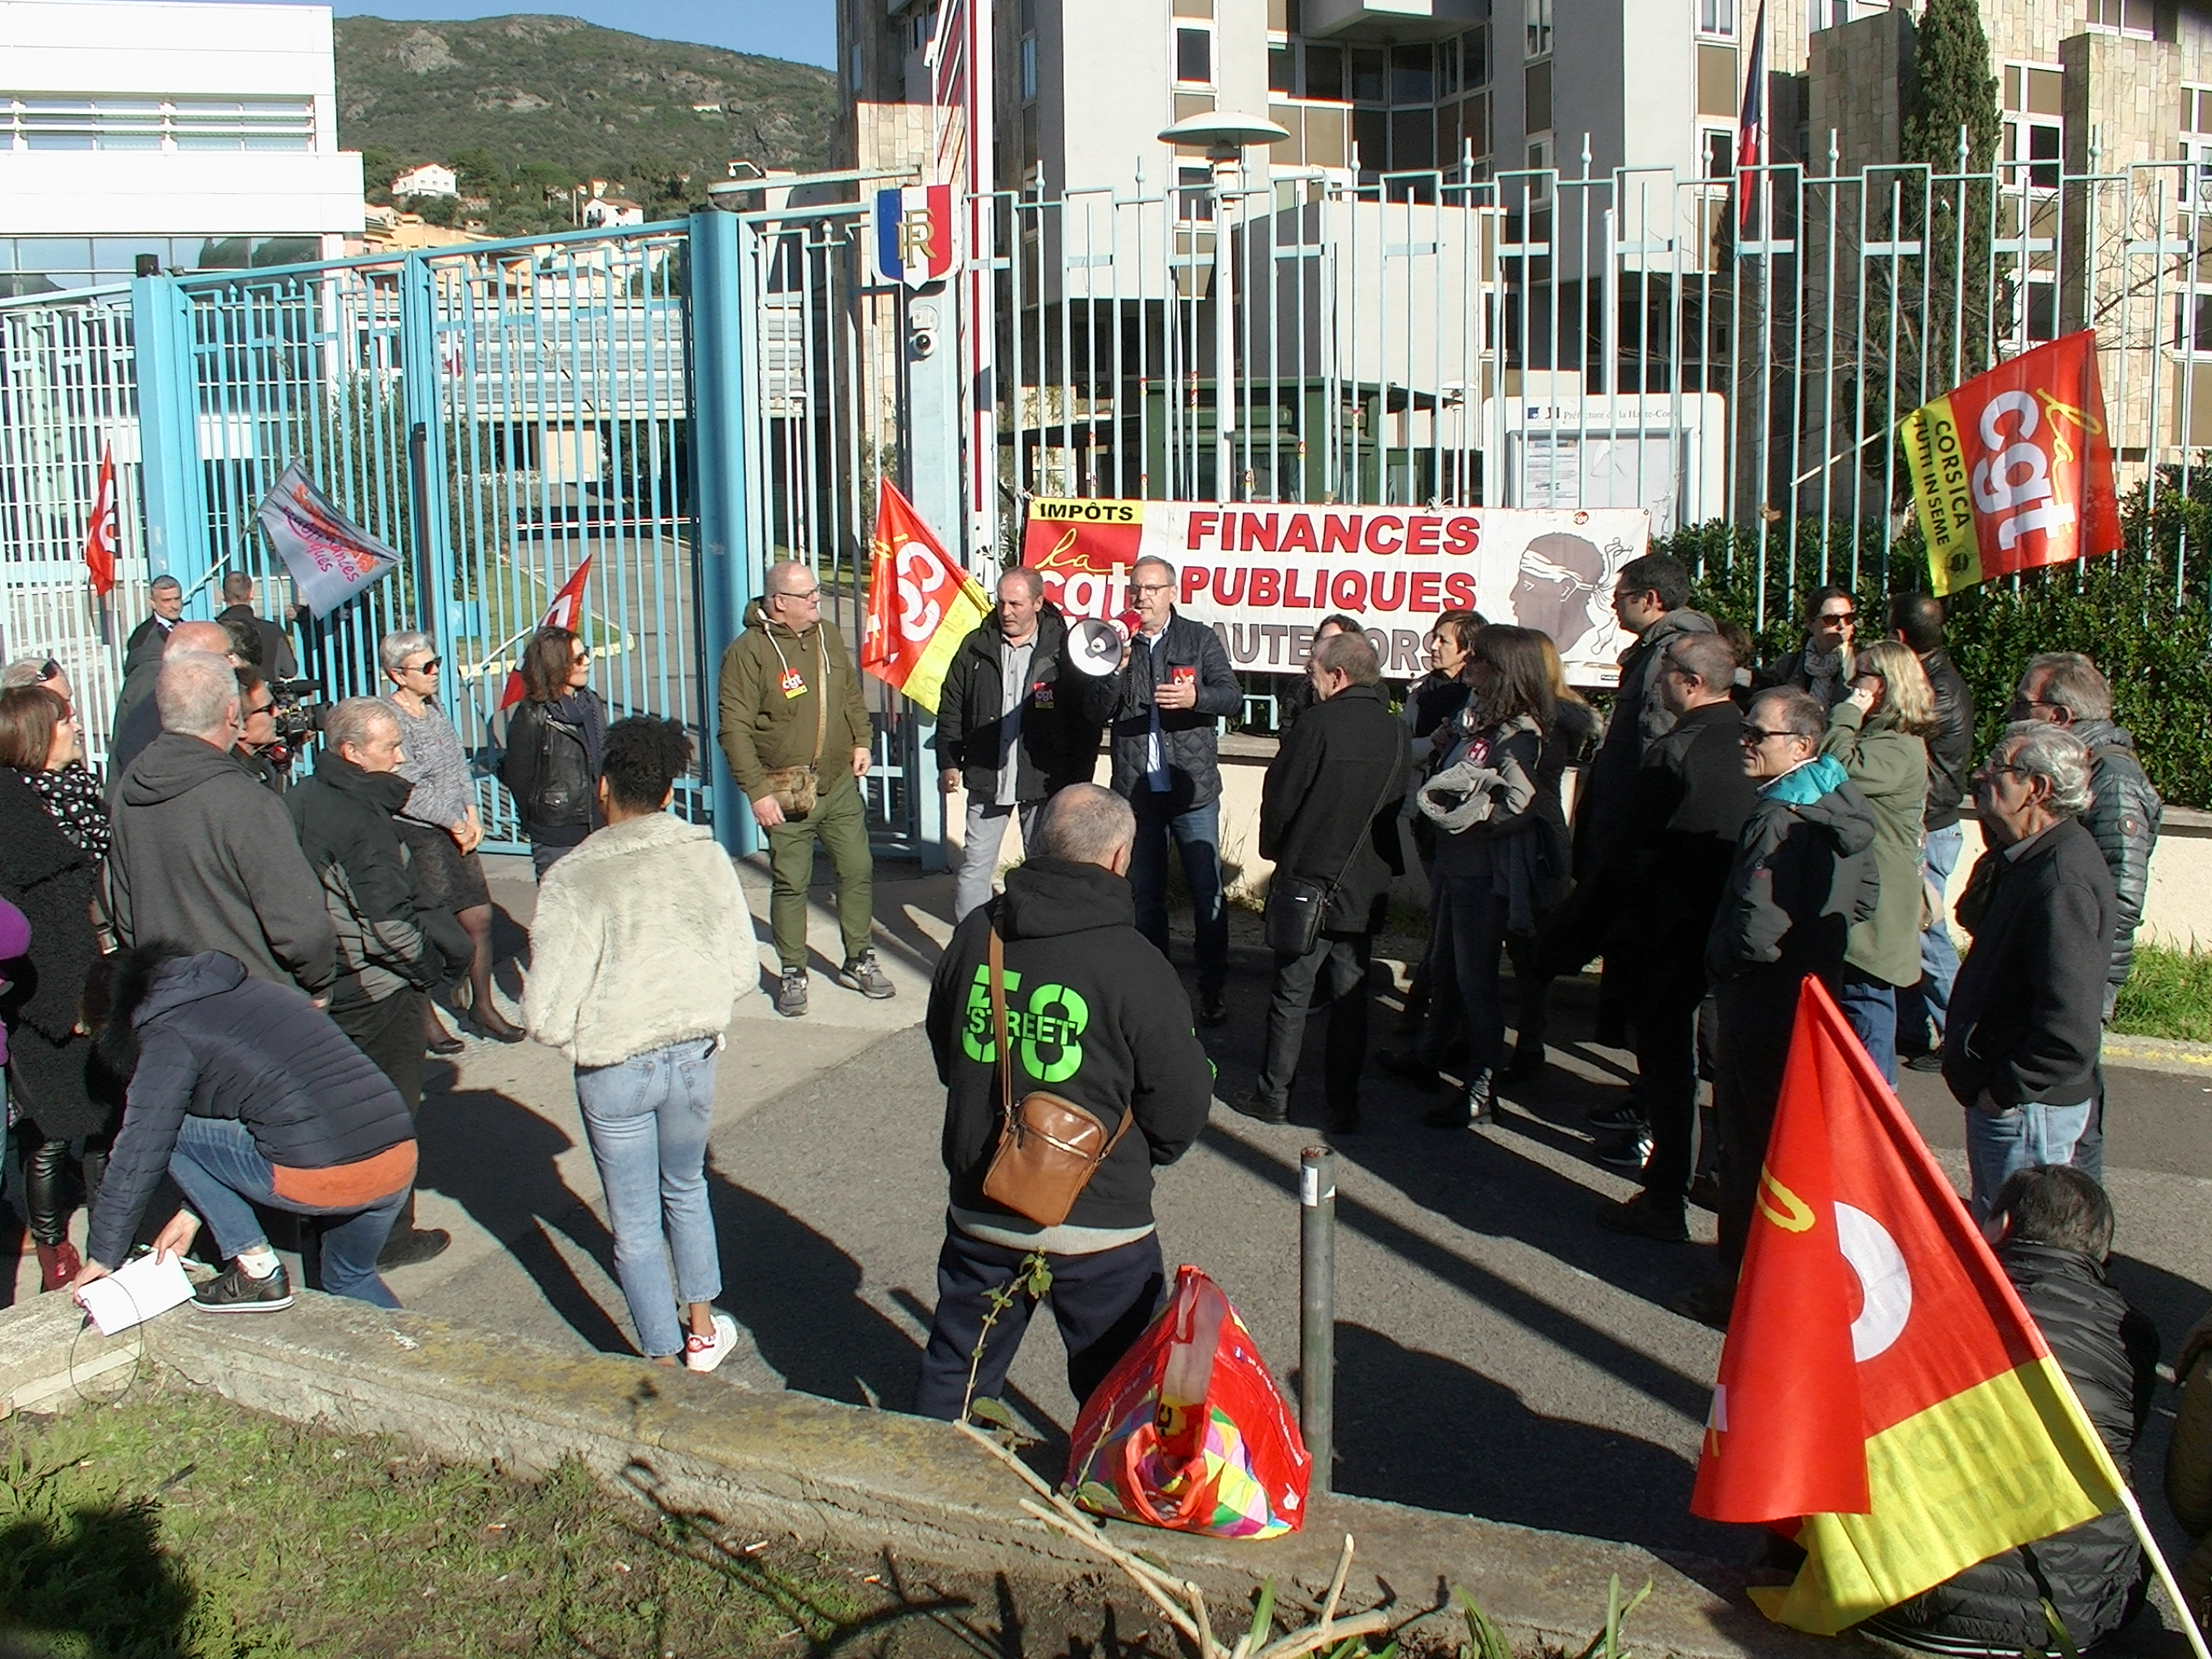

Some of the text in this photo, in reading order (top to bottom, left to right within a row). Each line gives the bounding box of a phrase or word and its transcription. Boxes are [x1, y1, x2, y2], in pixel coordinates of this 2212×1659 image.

[1914, 421, 1932, 467] TUTTI
[1935, 420, 1971, 529] CORSICA
[1972, 390, 2076, 551] cgt
[1040, 502, 1133, 521] IMPÔTS
[1187, 511, 1481, 555] FINANCES
[1039, 562, 1131, 631] cgt
[1181, 566, 1477, 614] PUBLIQUES
[1210, 621, 1314, 666] AUTE
[1035, 689, 1053, 701] cgt
